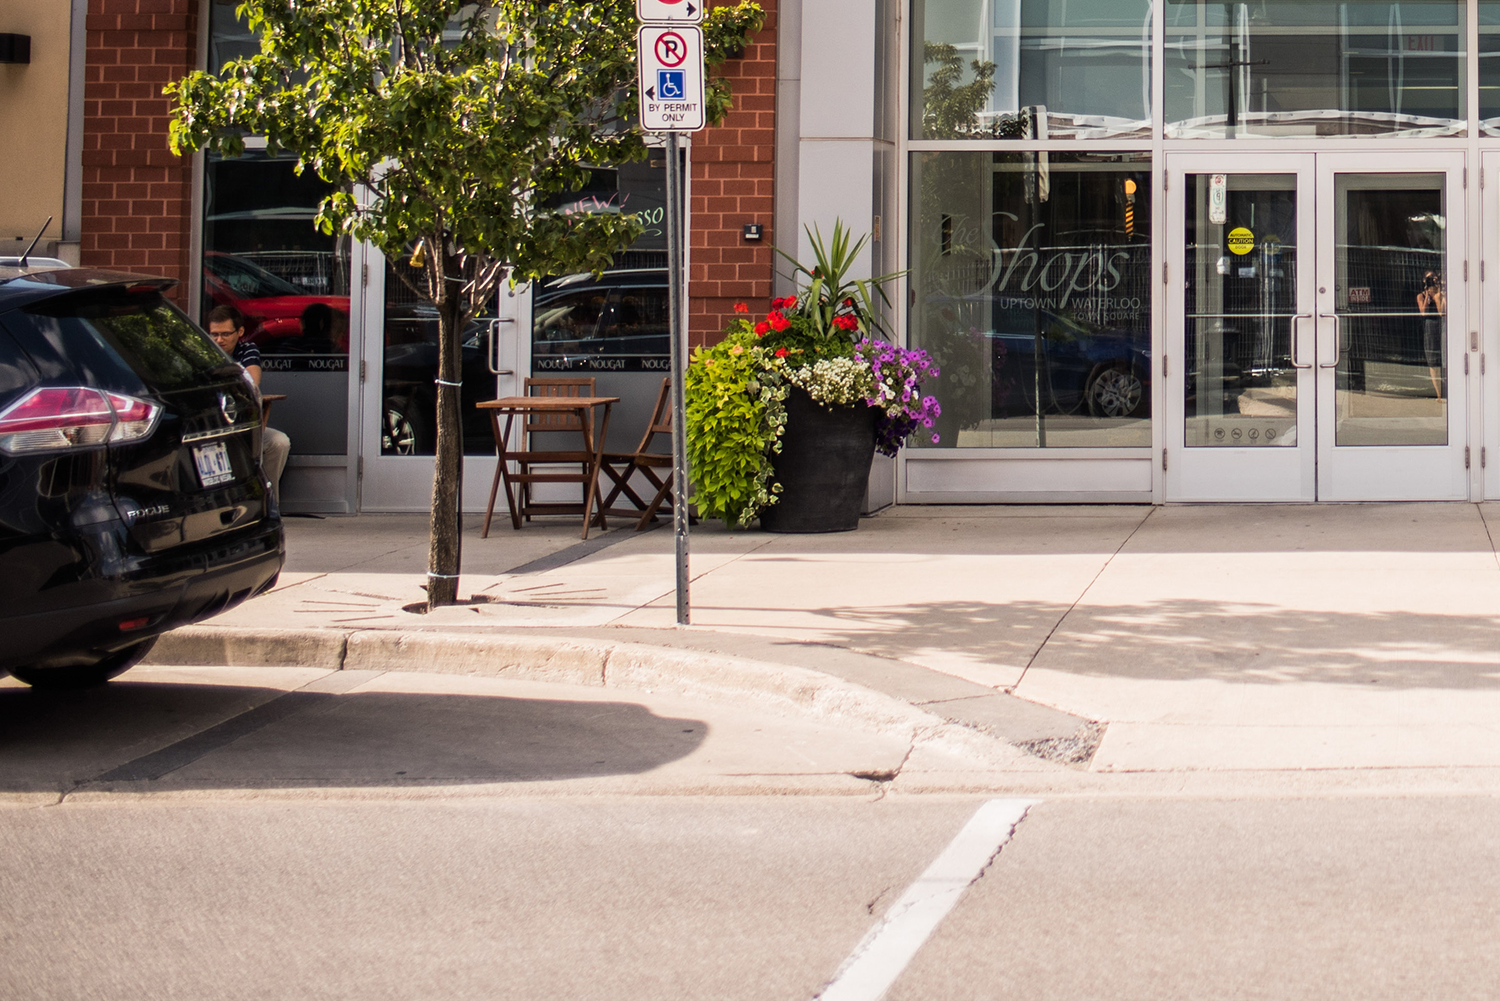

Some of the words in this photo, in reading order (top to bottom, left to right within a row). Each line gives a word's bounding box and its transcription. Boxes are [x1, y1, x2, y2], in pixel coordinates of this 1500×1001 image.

[649, 104, 661, 112] BY
[664, 103, 697, 112] PERMIT
[662, 114, 685, 122] ONLY
[931, 211, 1130, 309] Shops
[1000, 298, 1057, 309] UPTOWN
[1072, 298, 1141, 309] WATERLOO
[308, 359, 344, 369] NOUGAT
[538, 359, 573, 370] NOUGAT
[590, 359, 625, 370] NOUGAT
[642, 359, 671, 370] NOUG
[127, 505, 170, 519] ROGUE
